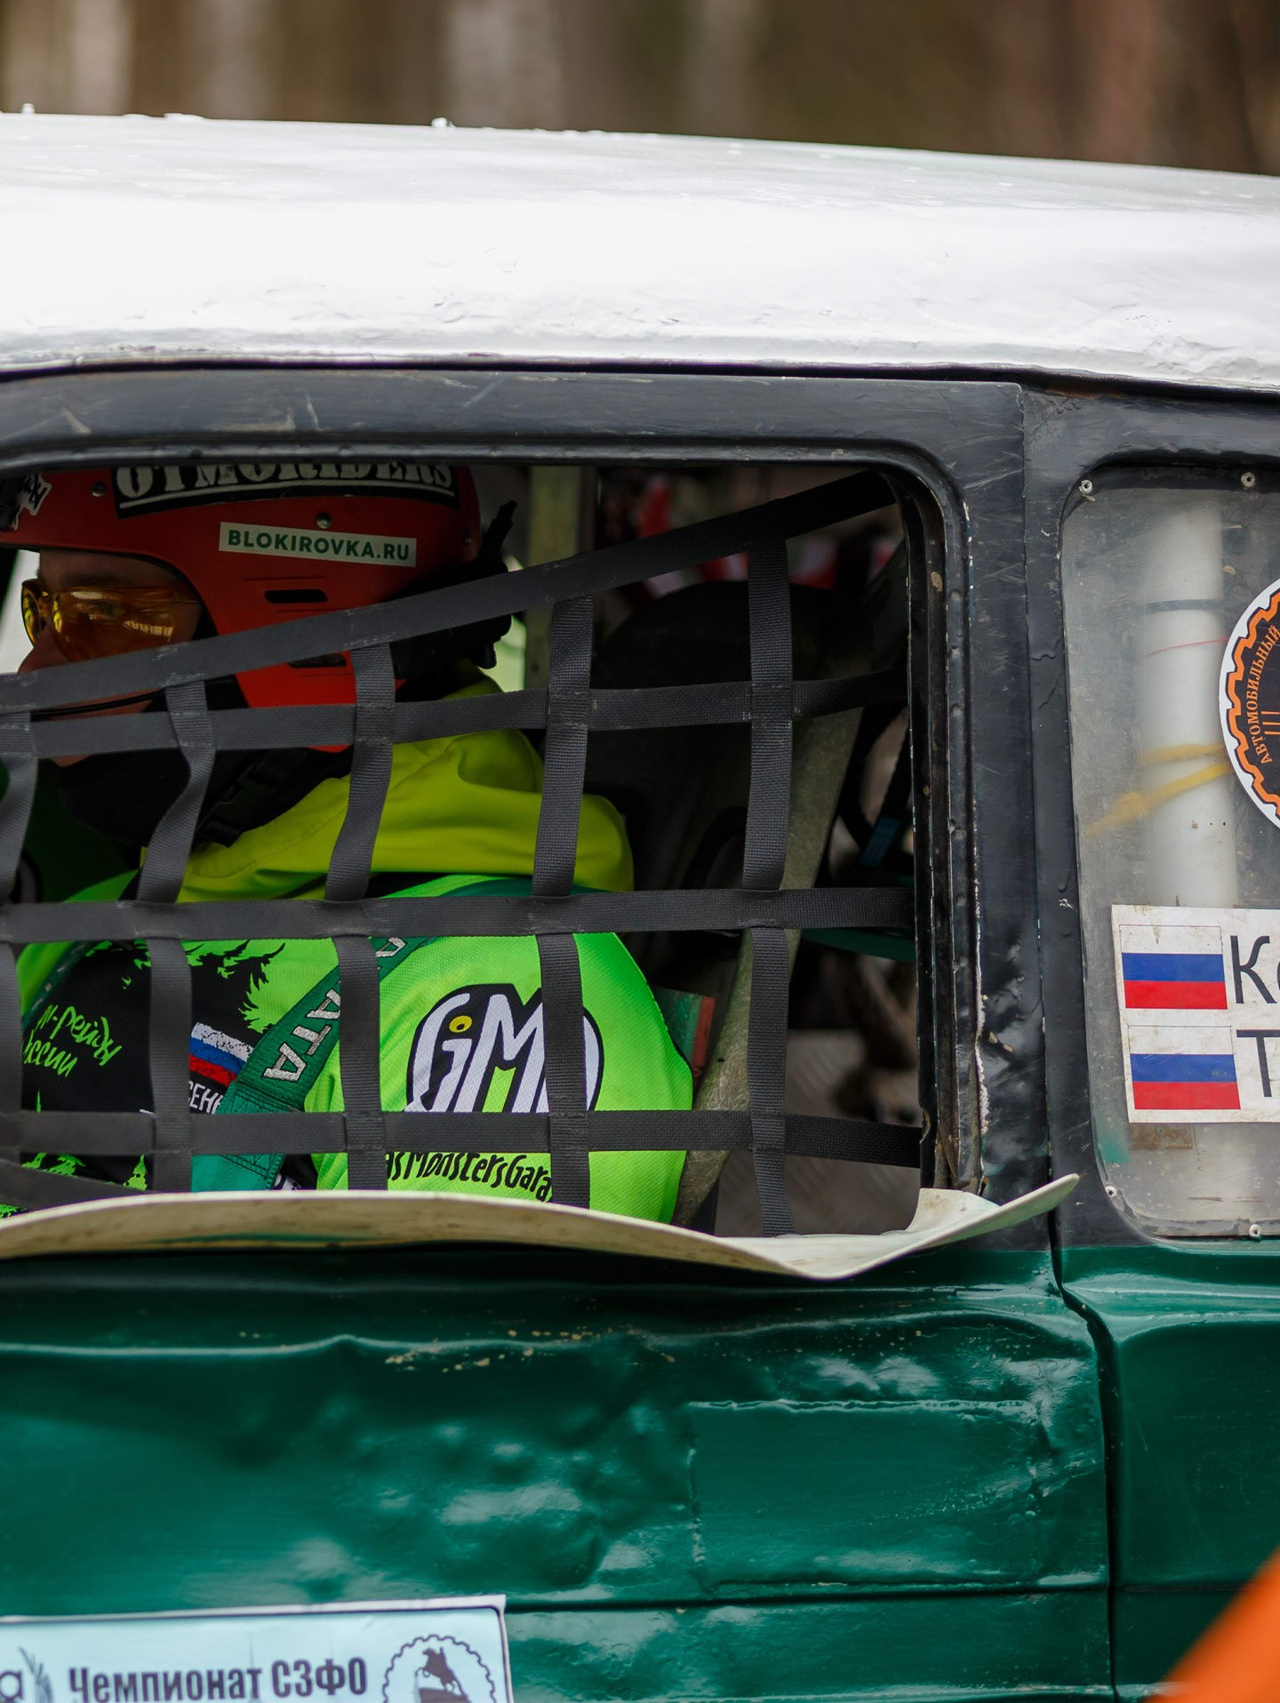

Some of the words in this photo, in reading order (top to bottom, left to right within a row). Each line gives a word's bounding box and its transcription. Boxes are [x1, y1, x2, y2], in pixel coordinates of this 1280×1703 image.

[228, 528, 410, 561] BLOKIROVKA.RU
[1246, 624, 1280, 765] АВТОМОБИЛЬНЫЙ
[1230, 935, 1280, 1004] К
[68, 1666, 263, 1703] Чемпионат
[271, 1656, 369, 1699] СЗФО
